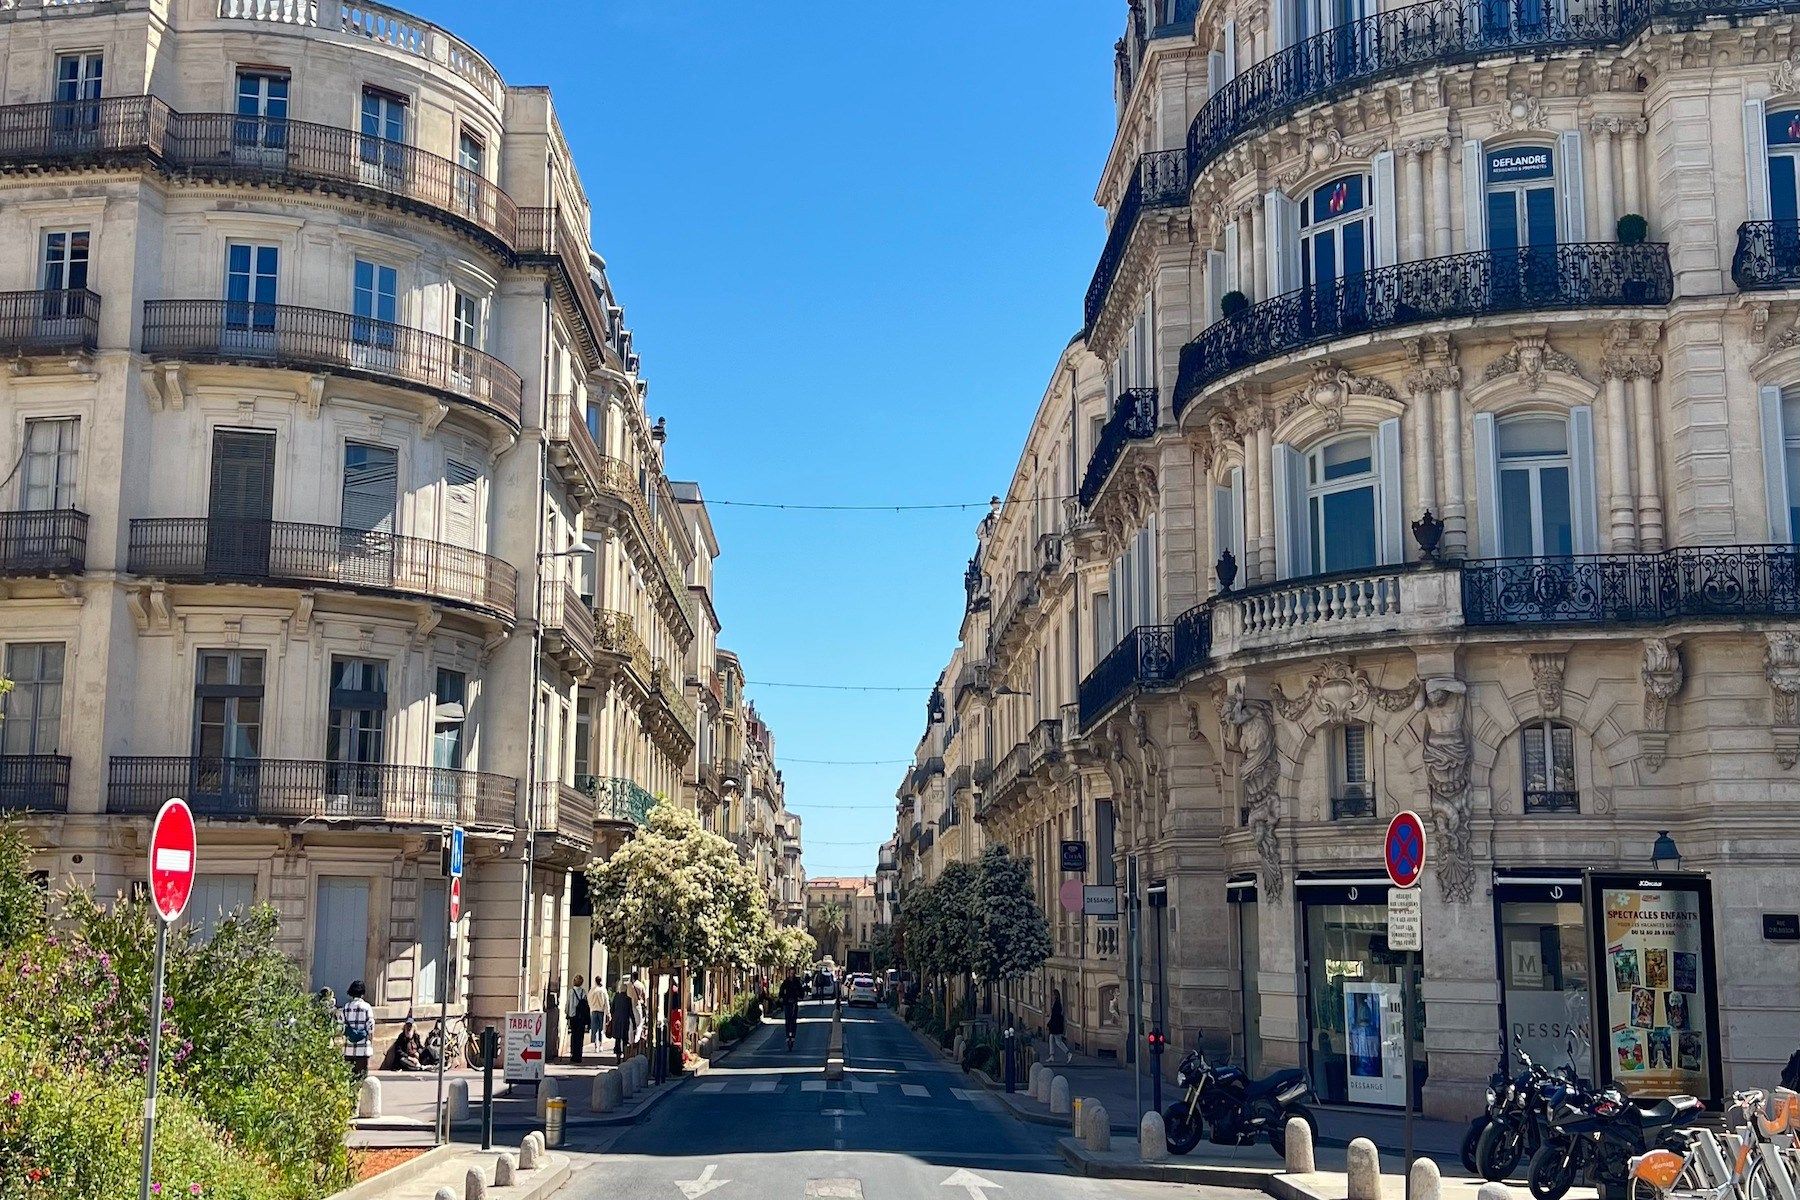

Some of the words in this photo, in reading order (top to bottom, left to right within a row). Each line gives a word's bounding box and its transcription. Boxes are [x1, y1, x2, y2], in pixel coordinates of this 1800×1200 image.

[1493, 154, 1547, 167] DEFLANDRE
[1607, 910, 1658, 920] SPECTACLES
[1660, 911, 1698, 920] ENFANTS
[1517, 954, 1537, 973] M
[508, 1018, 533, 1030] TABAC
[1350, 1081, 1383, 1091] DESSANGE
